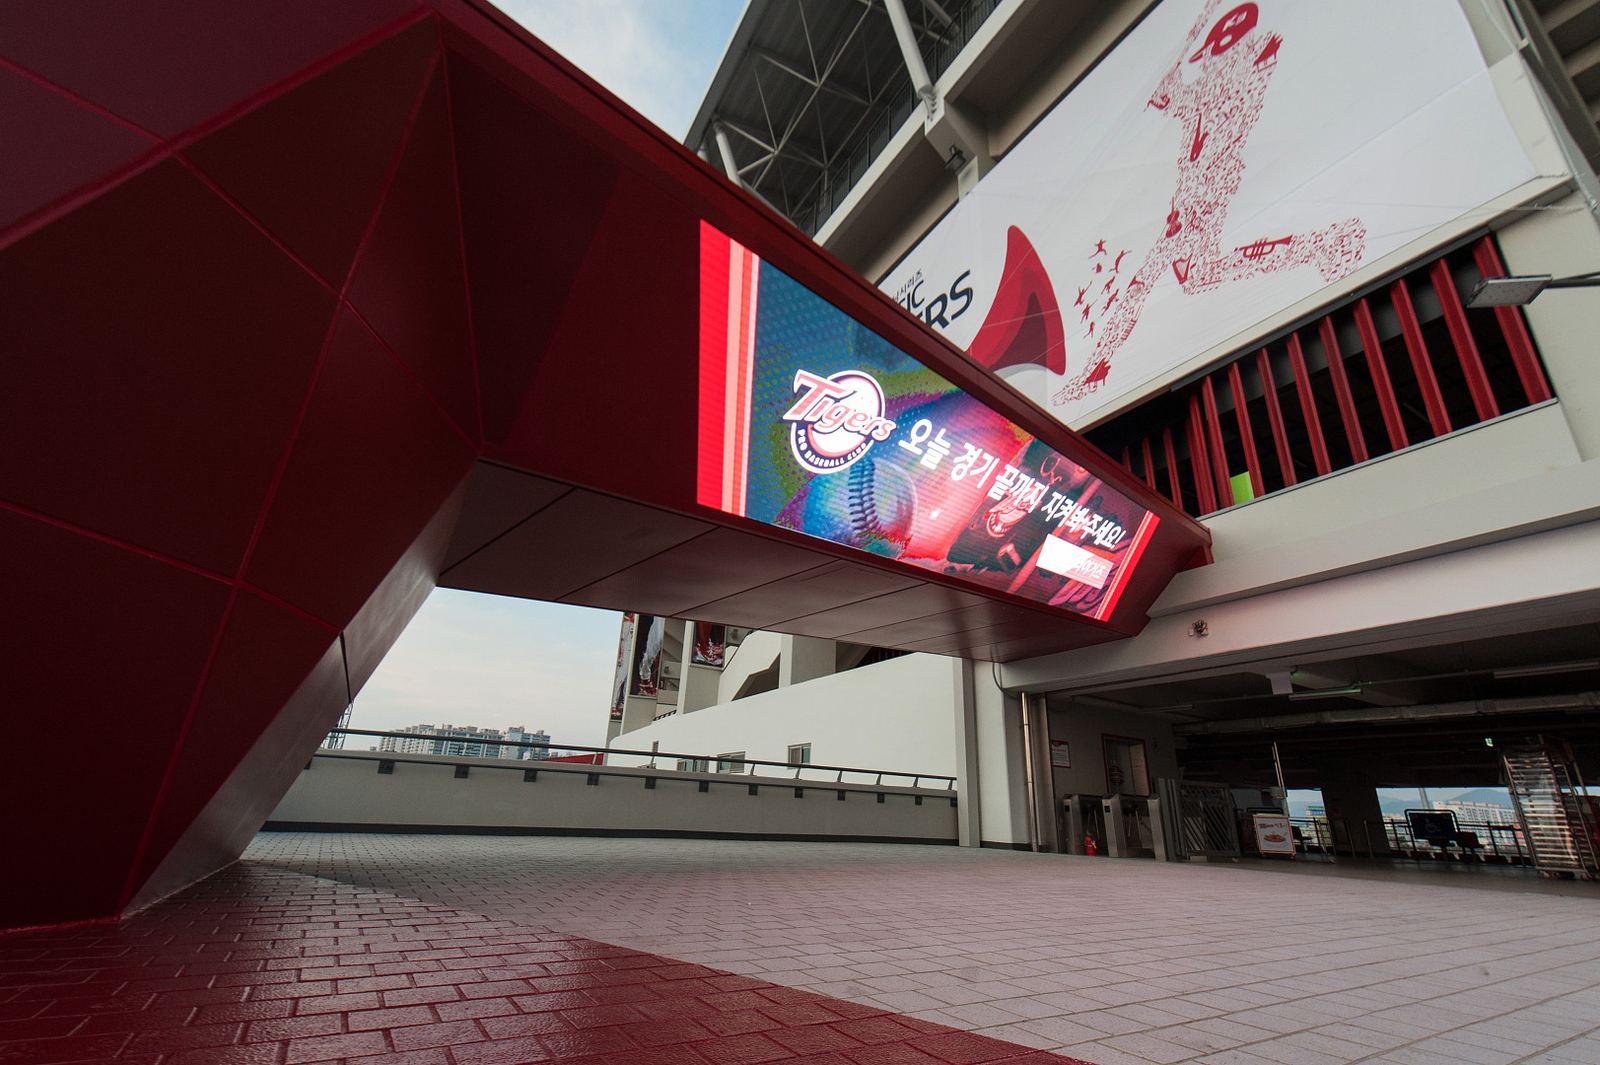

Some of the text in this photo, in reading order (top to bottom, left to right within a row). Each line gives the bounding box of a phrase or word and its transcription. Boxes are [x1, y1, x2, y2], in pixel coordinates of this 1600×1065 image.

[917, 269, 973, 329] RS
[783, 369, 897, 441] Tigers
[804, 450, 845, 467] BASEBALL
[847, 442, 867, 461] CLUB
[898, 418, 951, 470] 오늘
[951, 442, 1000, 489] 경기
[987, 464, 1050, 514] 끝까지
